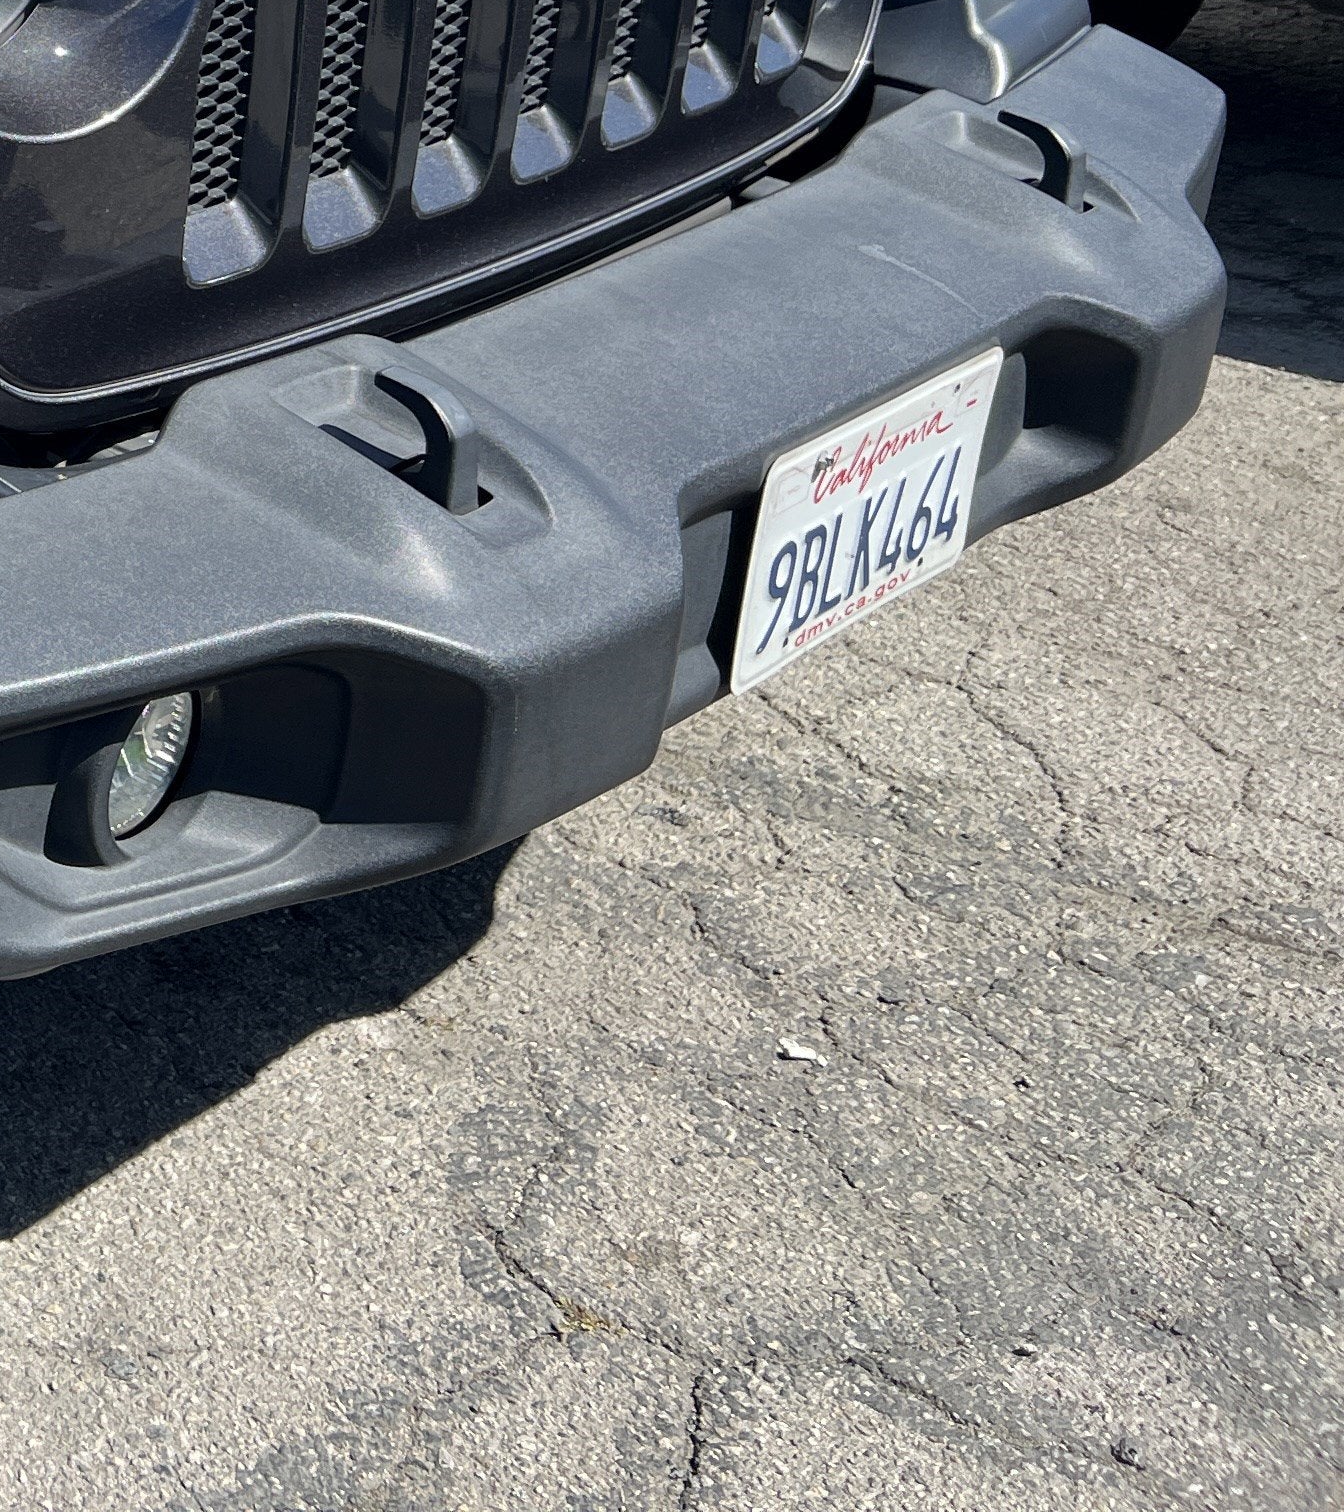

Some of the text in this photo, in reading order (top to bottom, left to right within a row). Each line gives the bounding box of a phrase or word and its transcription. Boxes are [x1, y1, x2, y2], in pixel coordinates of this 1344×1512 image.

[813, 410, 954, 505] California
[755, 445, 963, 655] 9BLK464
[793, 568, 912, 649] dmv.ca.gov
